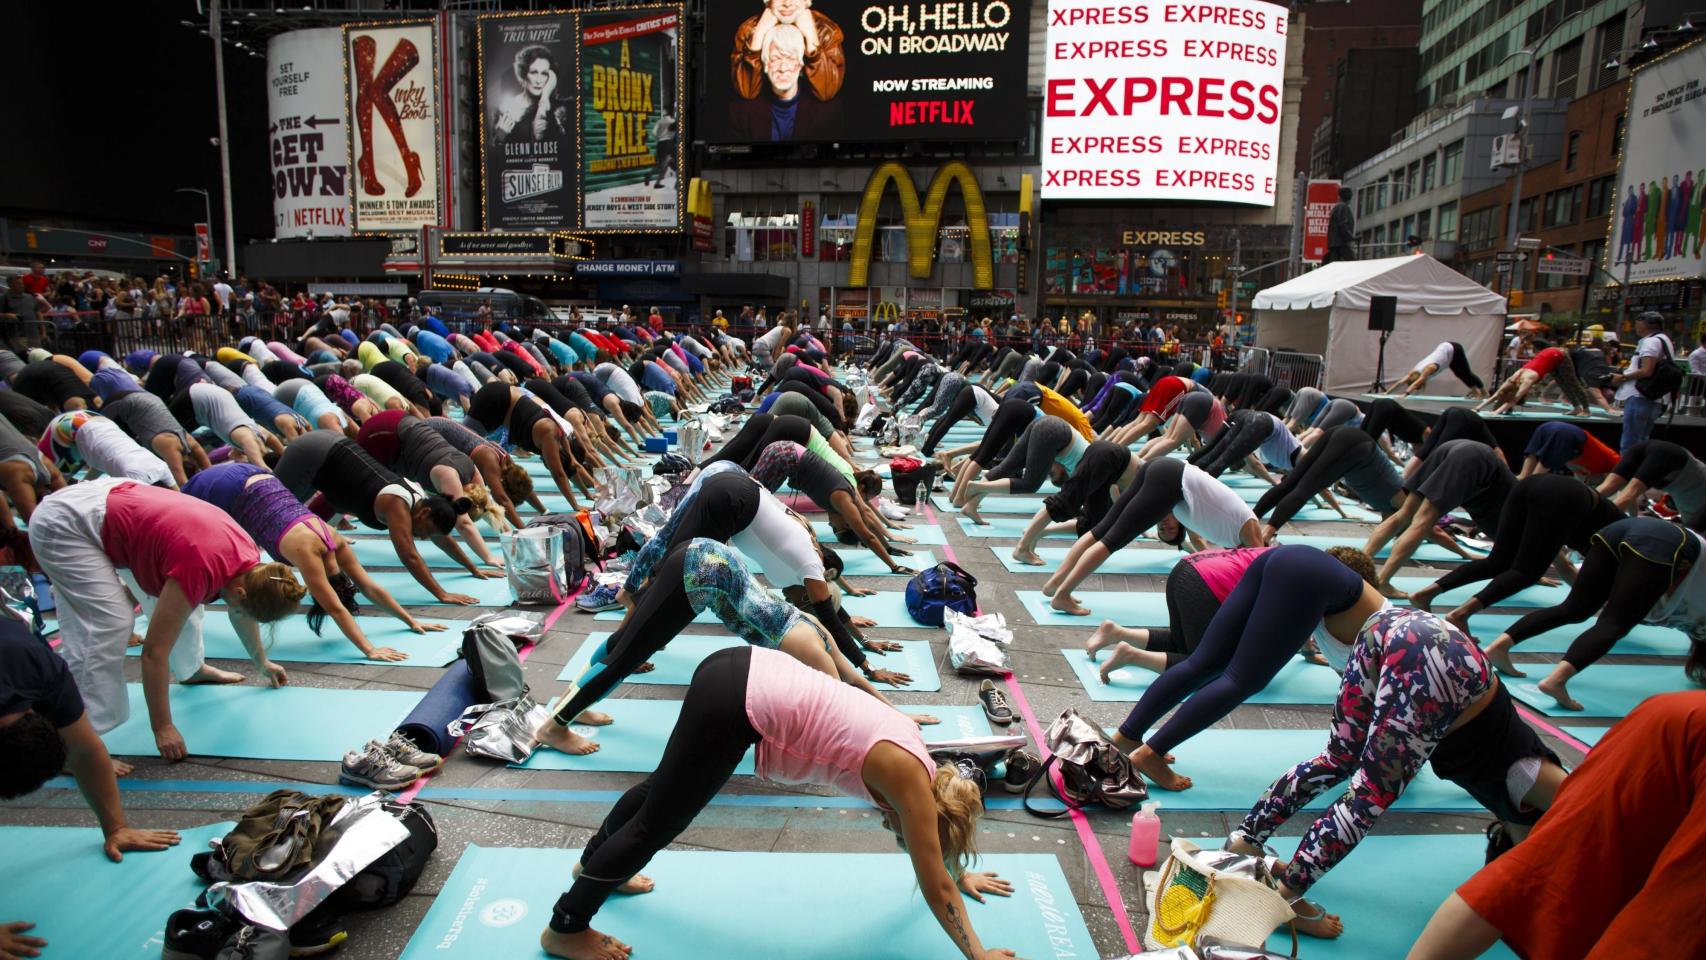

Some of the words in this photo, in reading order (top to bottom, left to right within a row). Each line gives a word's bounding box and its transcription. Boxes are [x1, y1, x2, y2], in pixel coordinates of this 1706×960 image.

[861, 5, 917, 35] OH,
[919, 1, 1011, 31] HELLO
[1047, 5, 1149, 27] XPRESS
[1164, 4, 1266, 30] EXPRESS
[620, 38, 630, 68] A
[861, 36, 893, 55] ON
[898, 32, 1010, 54] BROADWAY
[1054, 39, 1168, 60] EXPRESS
[1183, 39, 1278, 67] EXPRESS
[272, 71, 311, 88] YOURSELF
[279, 62, 294, 74] SET
[279, 85, 299, 97] FREE
[593, 64, 653, 112] BRONX
[872, 79, 909, 92] NOW
[911, 77, 994, 91] STREAMING
[1046, 76, 1279, 125] EXPRESS
[279, 116, 302, 131] THE
[890, 100, 975, 127] NETFLIX
[602, 110, 649, 155] TALE
[272, 133, 324, 167] GET
[505, 142, 531, 156] GLENN
[533, 141, 559, 154] CLOSE
[1050, 135, 1163, 154] EXPRESS
[1178, 136, 1271, 161] EXPRESS
[509, 174, 546, 197] SUNSET
[1041, 168, 1141, 187] XPRESS
[1155, 169, 1256, 192] EXPRESS
[392, 200, 408, 209] TONY
[409, 199, 435, 209] AWARDS
[294, 207, 346, 228] NETFLIX
[1122, 231, 1206, 246] EXPRESS
[576, 263, 615, 272] CHANGE
[616, 263, 650, 272] MONEY
[655, 263, 676, 272] ATM
